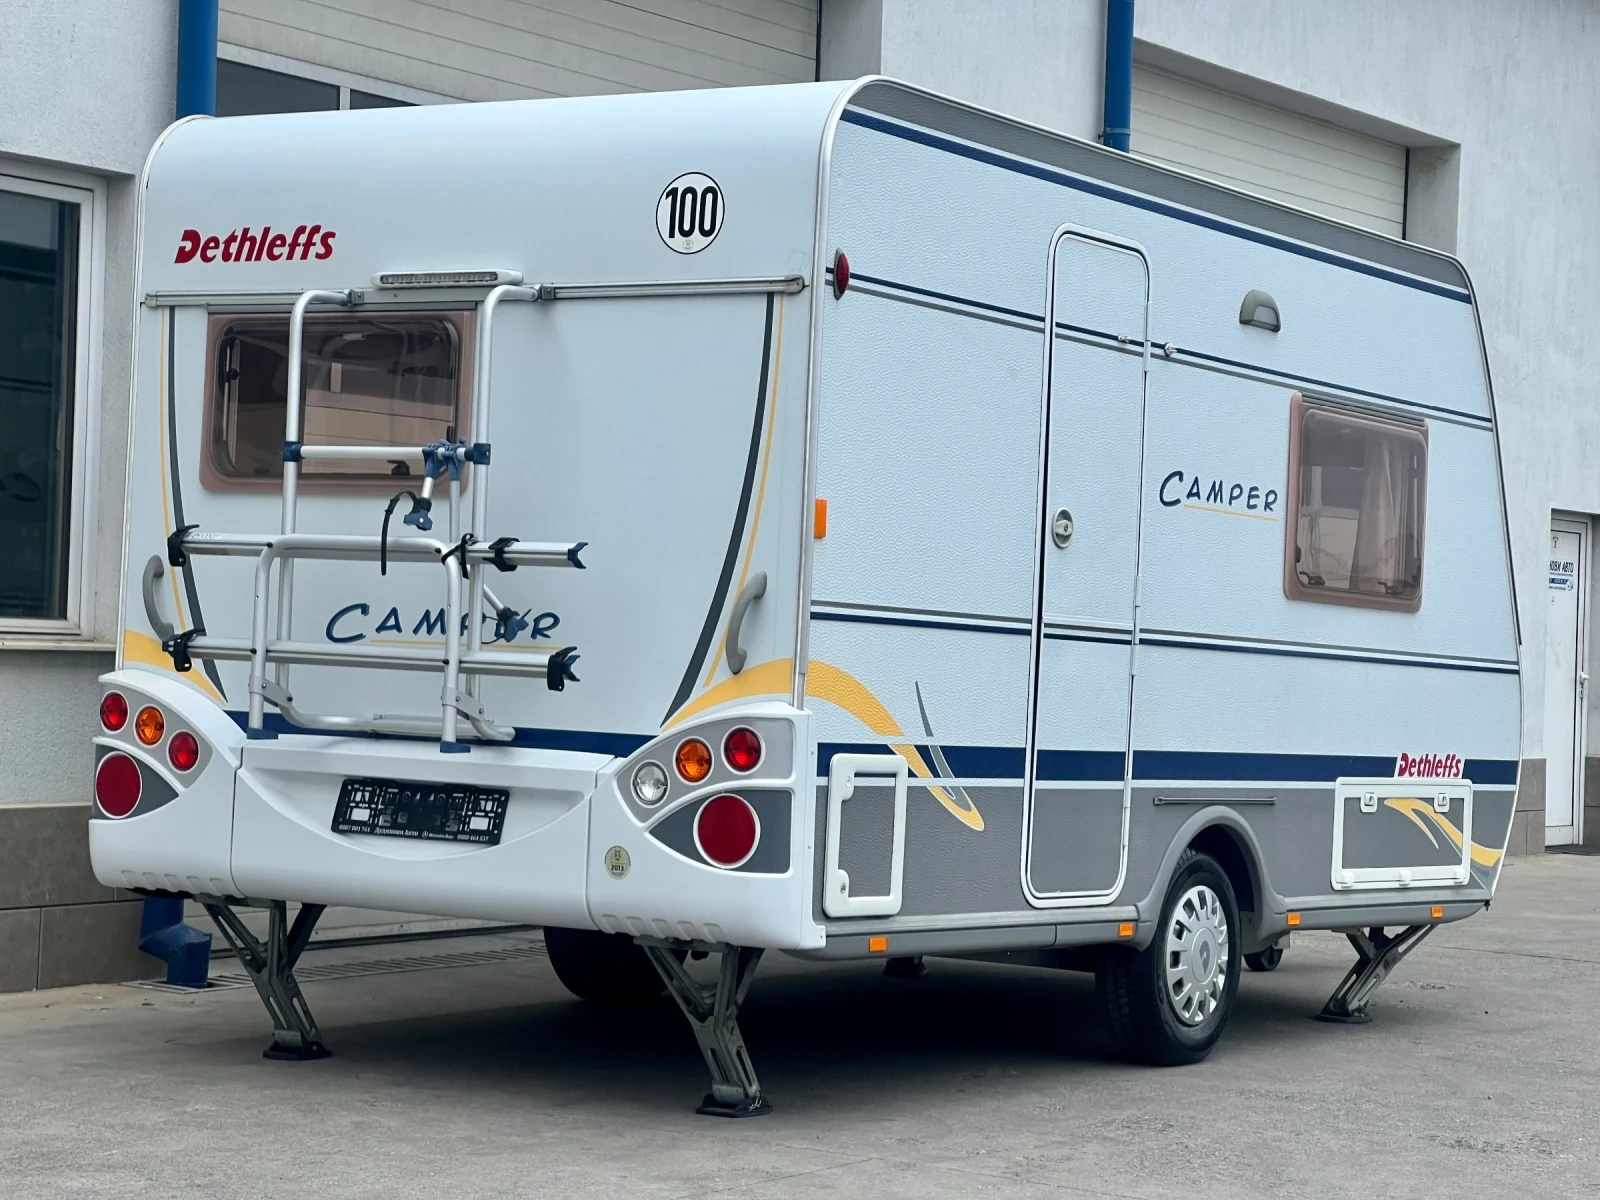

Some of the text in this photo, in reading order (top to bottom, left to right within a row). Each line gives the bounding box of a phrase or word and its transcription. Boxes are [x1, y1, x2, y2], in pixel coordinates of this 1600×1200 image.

[665, 185, 719, 239] 100
[174, 224, 337, 264] Dethleffs
[1159, 470, 1278, 512] CAMPER
[1398, 752, 1462, 778] Dethleffs
